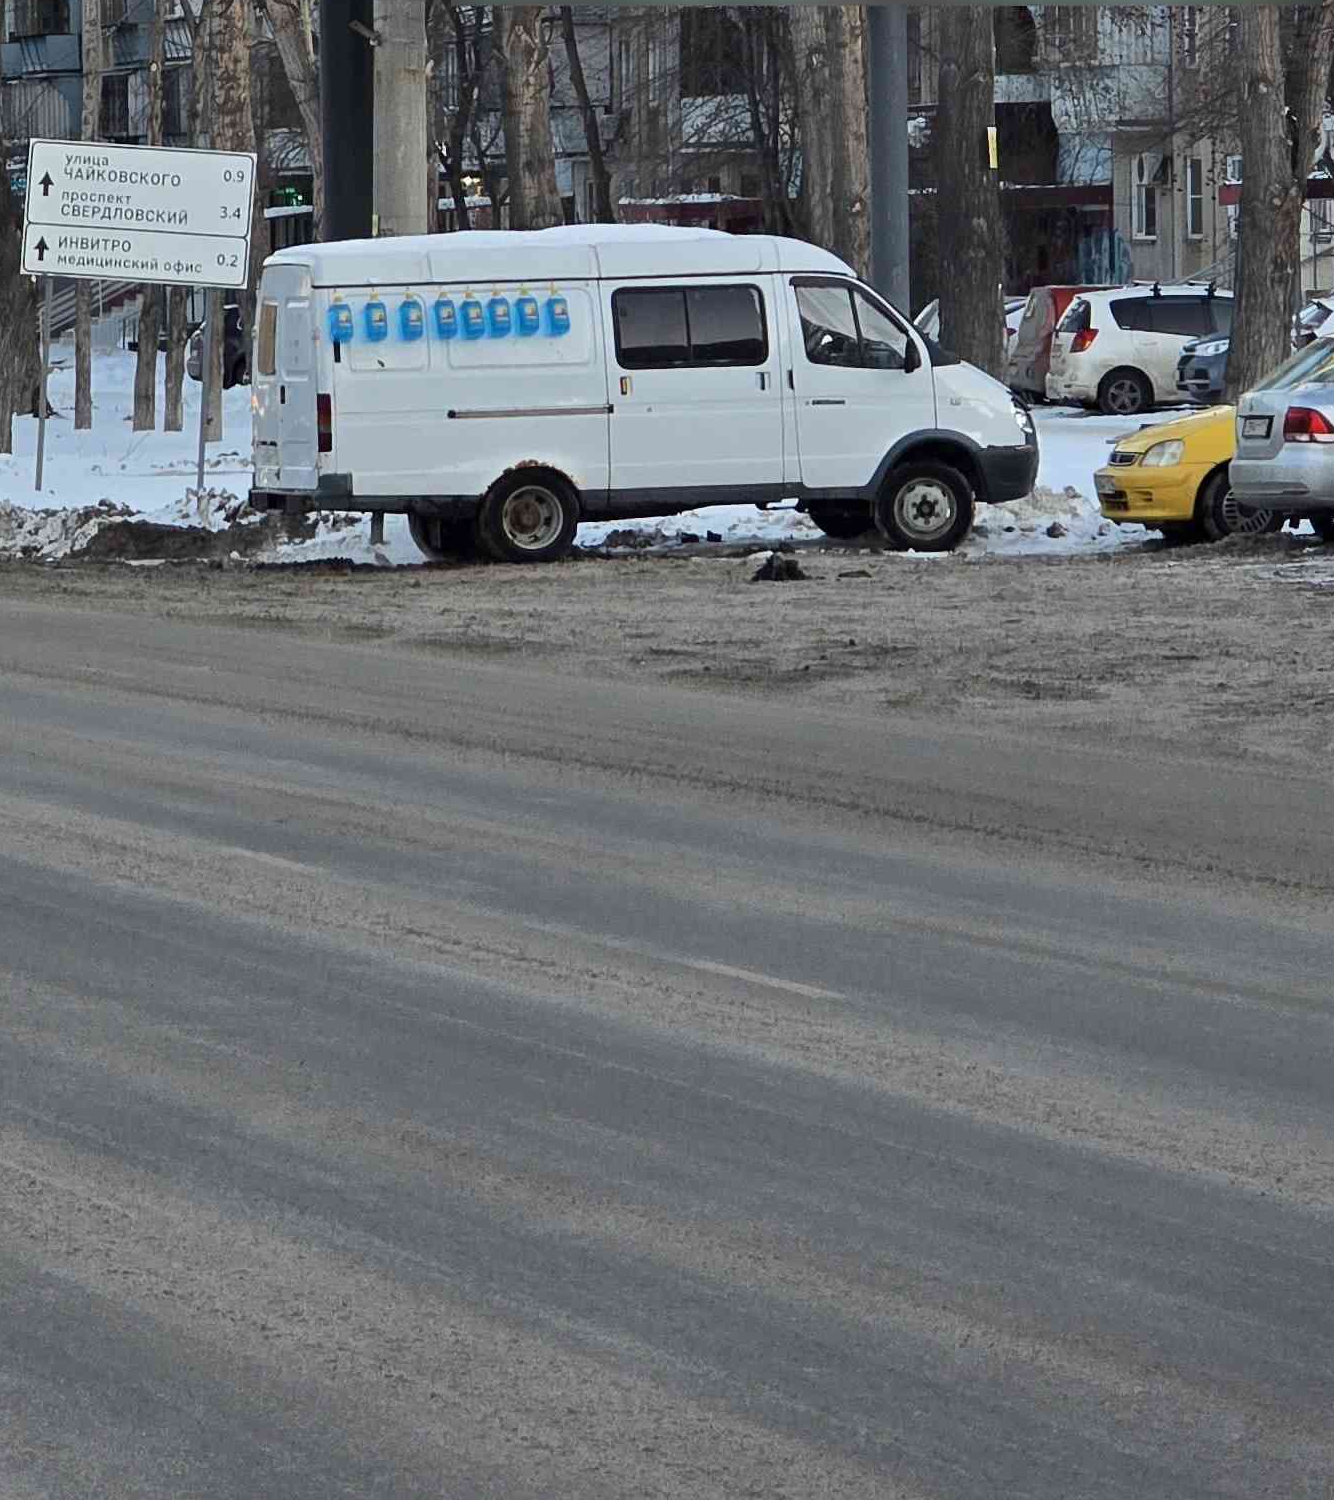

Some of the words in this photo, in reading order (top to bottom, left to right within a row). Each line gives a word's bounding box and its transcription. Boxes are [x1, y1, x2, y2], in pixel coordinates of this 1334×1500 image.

[65, 153, 109, 167] улица
[64, 166, 181, 187] ЧАЙКОВСКОГО
[223, 169, 245, 183] 0.9
[61, 191, 132, 205] проспект
[60, 203, 188, 225] СВЕРДЛОВСКИЙ
[219, 206, 241, 220] 3.4
[57, 235, 132, 253] ИНВИТРО
[56, 253, 159, 273] медицинский
[163, 260, 203, 276] офис
[216, 254, 239, 268] 0.2
